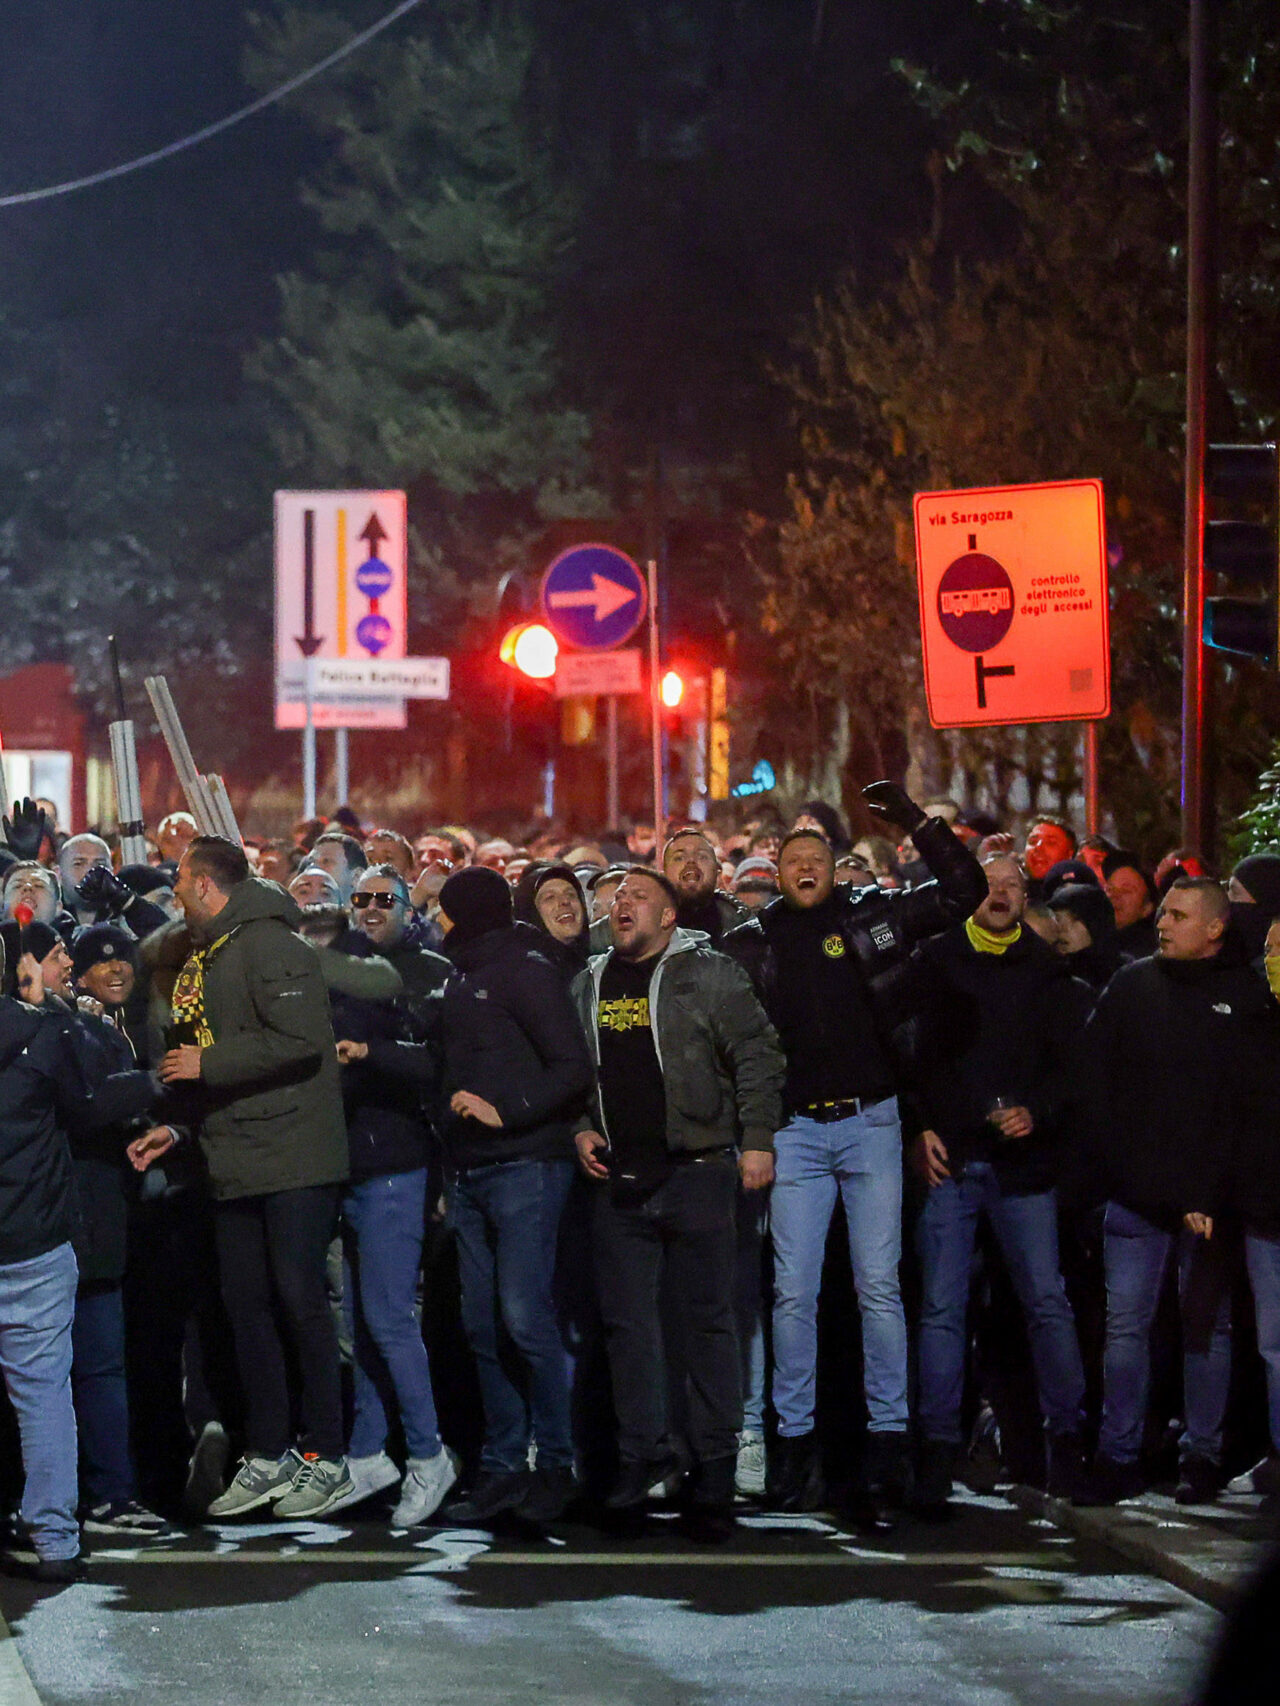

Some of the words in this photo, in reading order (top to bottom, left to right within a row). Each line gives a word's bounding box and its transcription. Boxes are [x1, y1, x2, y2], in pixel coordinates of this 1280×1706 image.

[929, 512, 946, 526] via
[951, 510, 1013, 526] Saragozza
[1031, 574, 1080, 587] controllo
[1026, 588, 1086, 601] elettronico
[1020, 602, 1047, 617] degli
[1053, 599, 1093, 613] accessi
[873, 931, 894, 946] ICON
